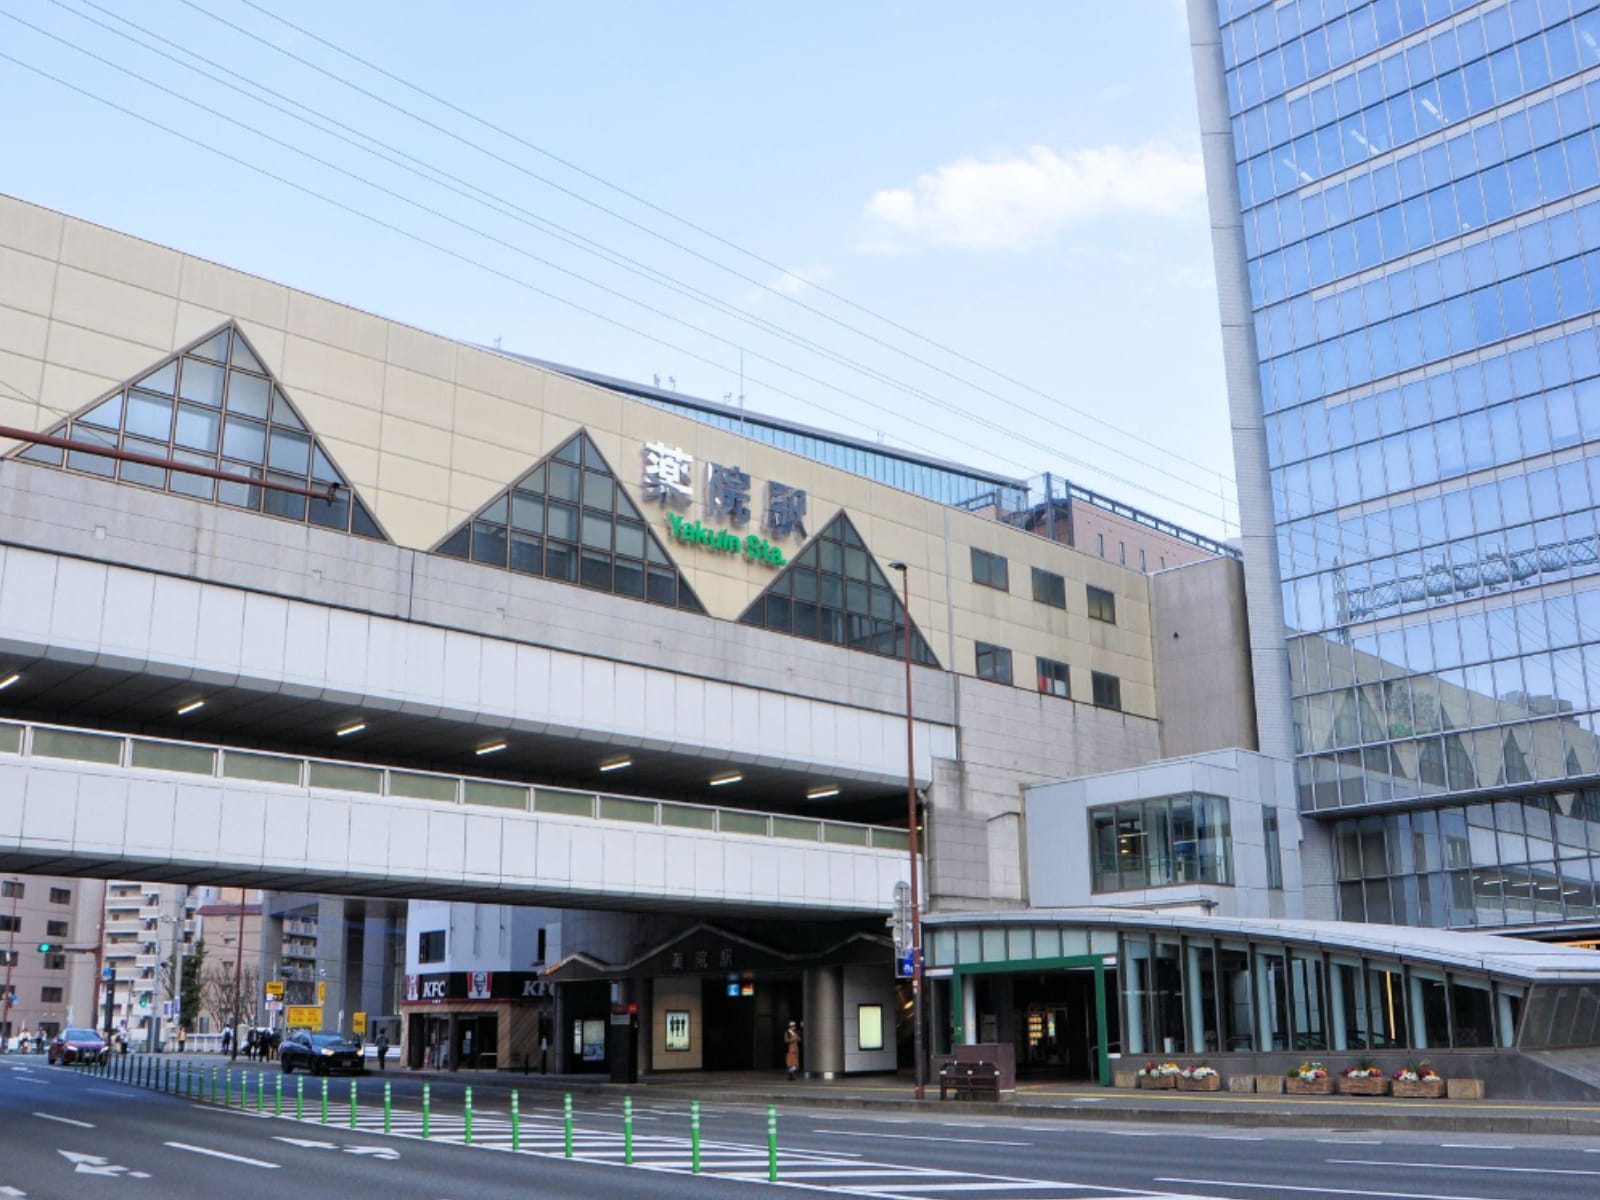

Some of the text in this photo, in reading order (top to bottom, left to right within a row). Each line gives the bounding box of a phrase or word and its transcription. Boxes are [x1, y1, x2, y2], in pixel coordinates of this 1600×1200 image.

[643, 441, 807, 538] 薬院駅
[668, 512, 787, 566] Yakuin Sta.
[422, 980, 446, 998] KFC
